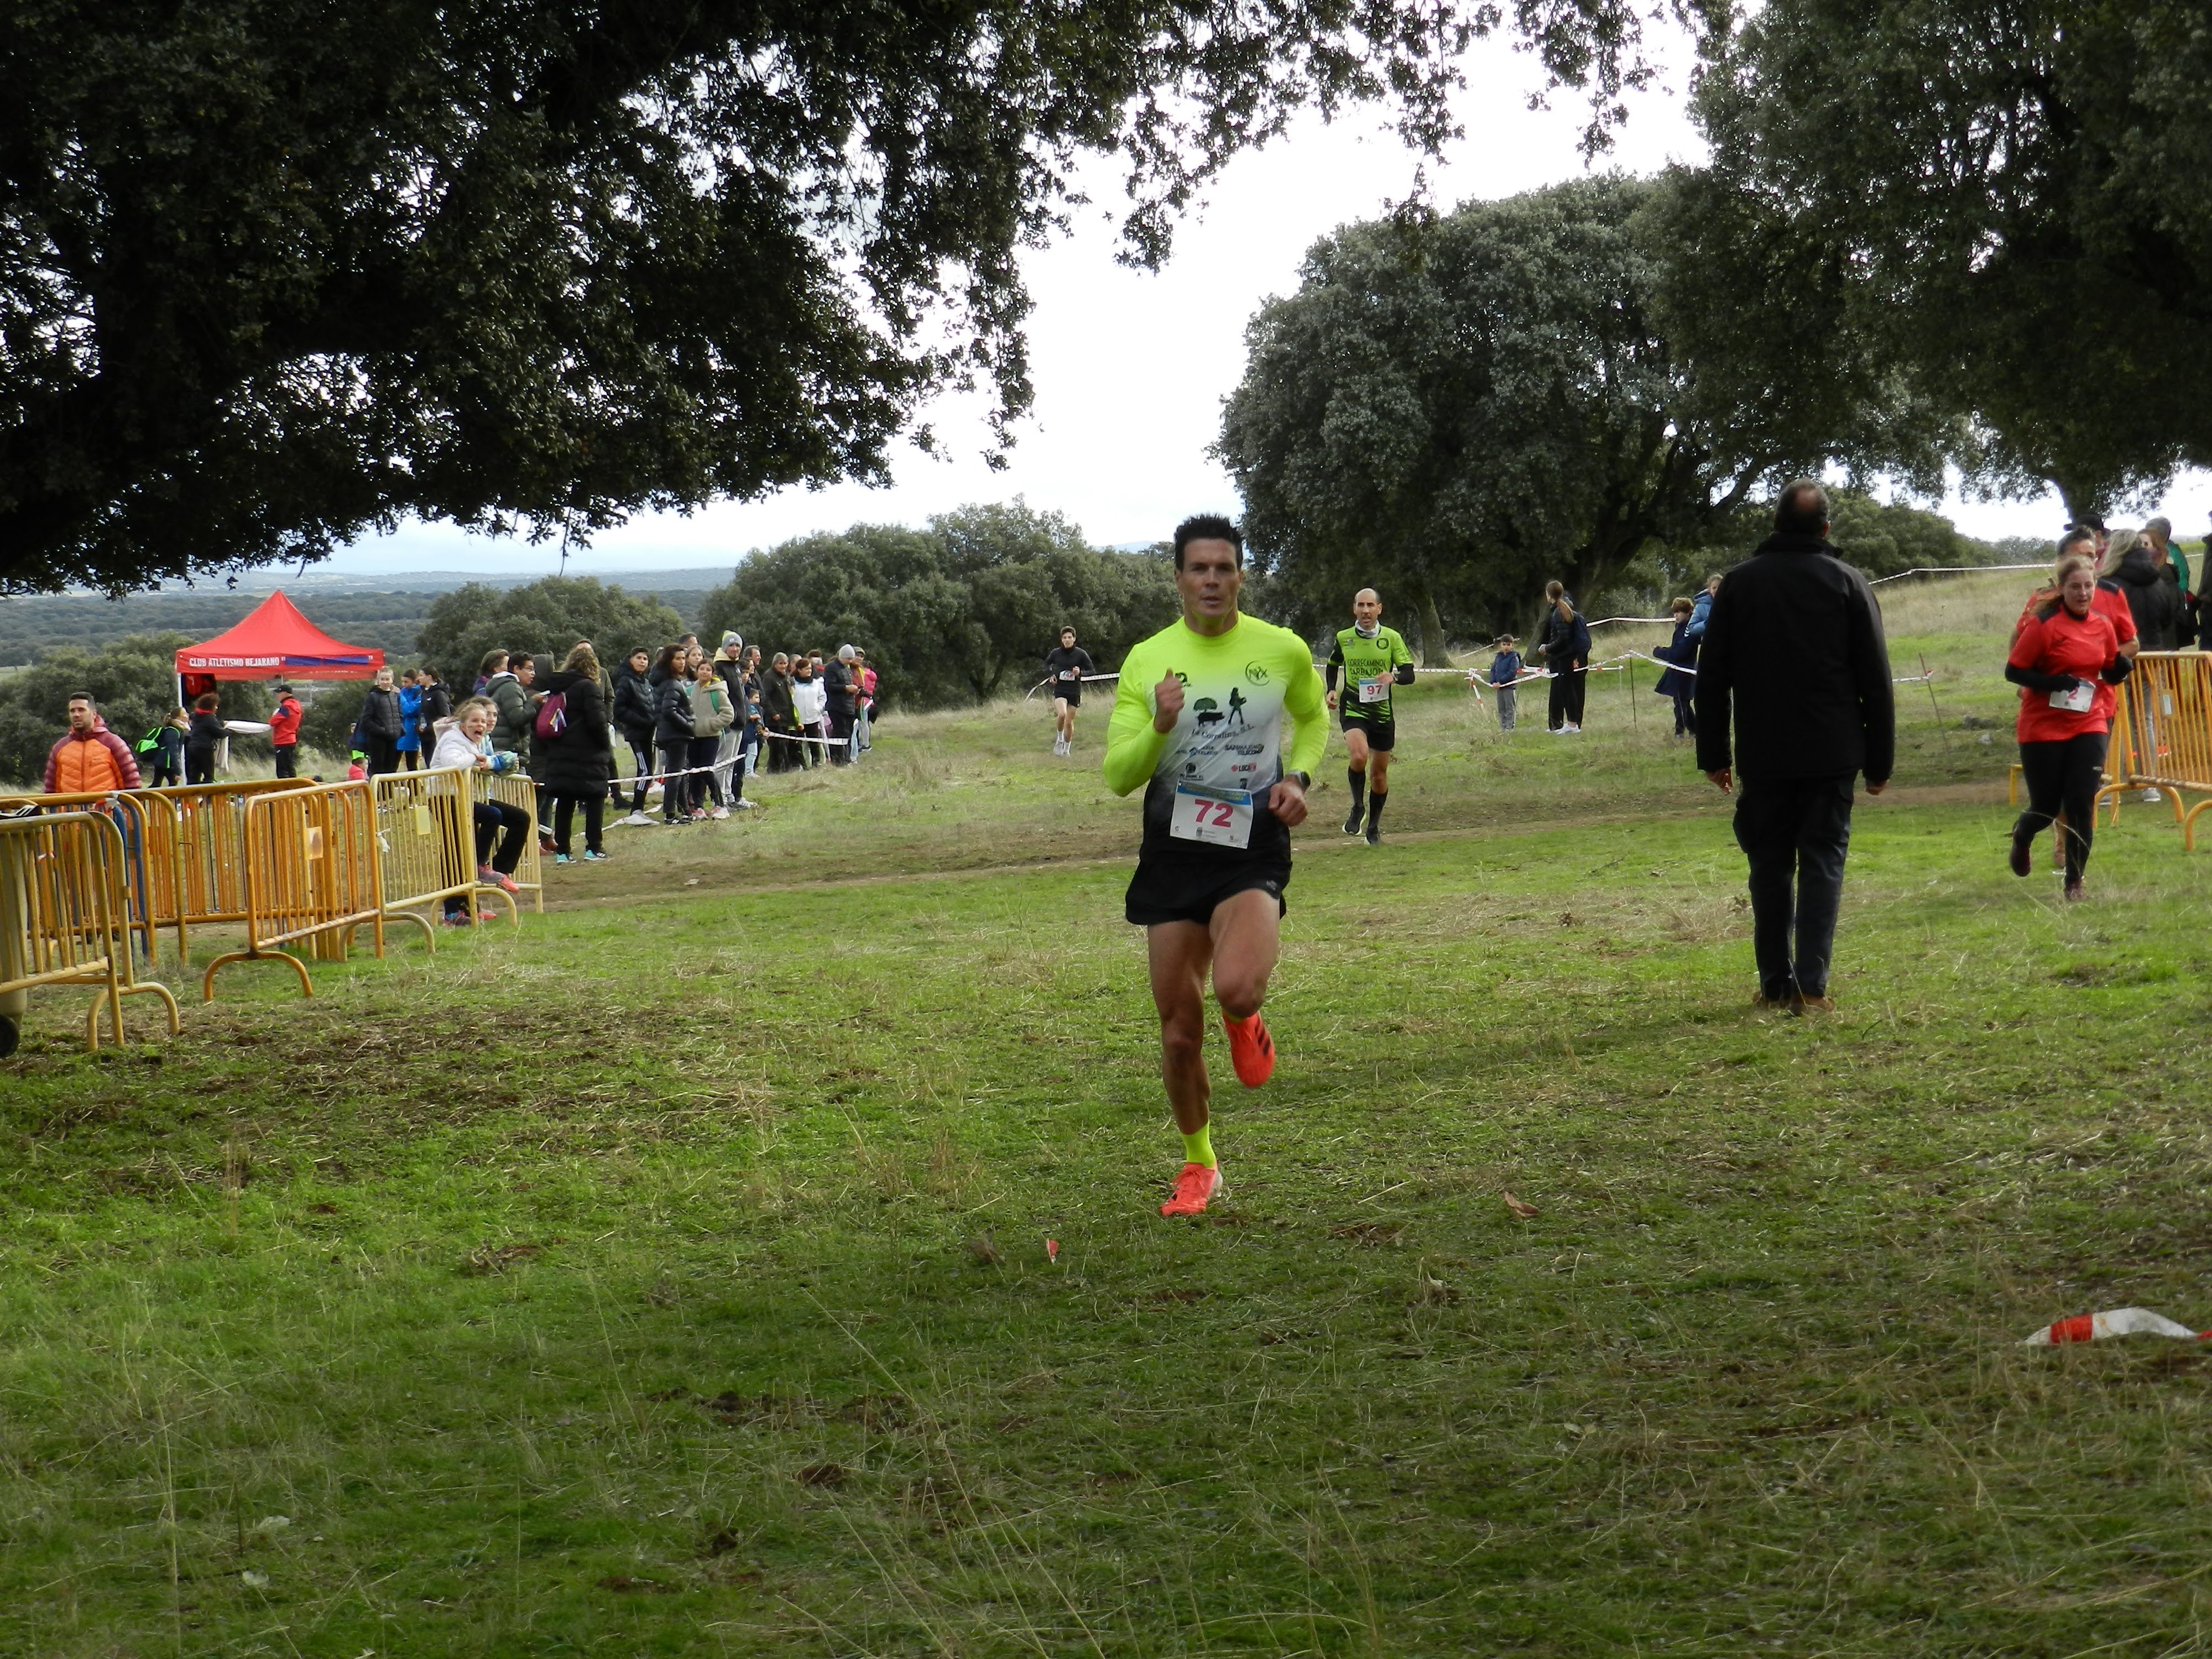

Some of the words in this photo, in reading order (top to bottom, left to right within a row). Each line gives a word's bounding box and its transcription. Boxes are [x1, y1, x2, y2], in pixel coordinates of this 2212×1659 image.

[190, 658, 206, 666] CLUB
[208, 658, 243, 666] ATLETISMO
[245, 657, 279, 666] BEJARANO
[1367, 685, 1383, 695] 97
[1194, 799, 1233, 828] 72
